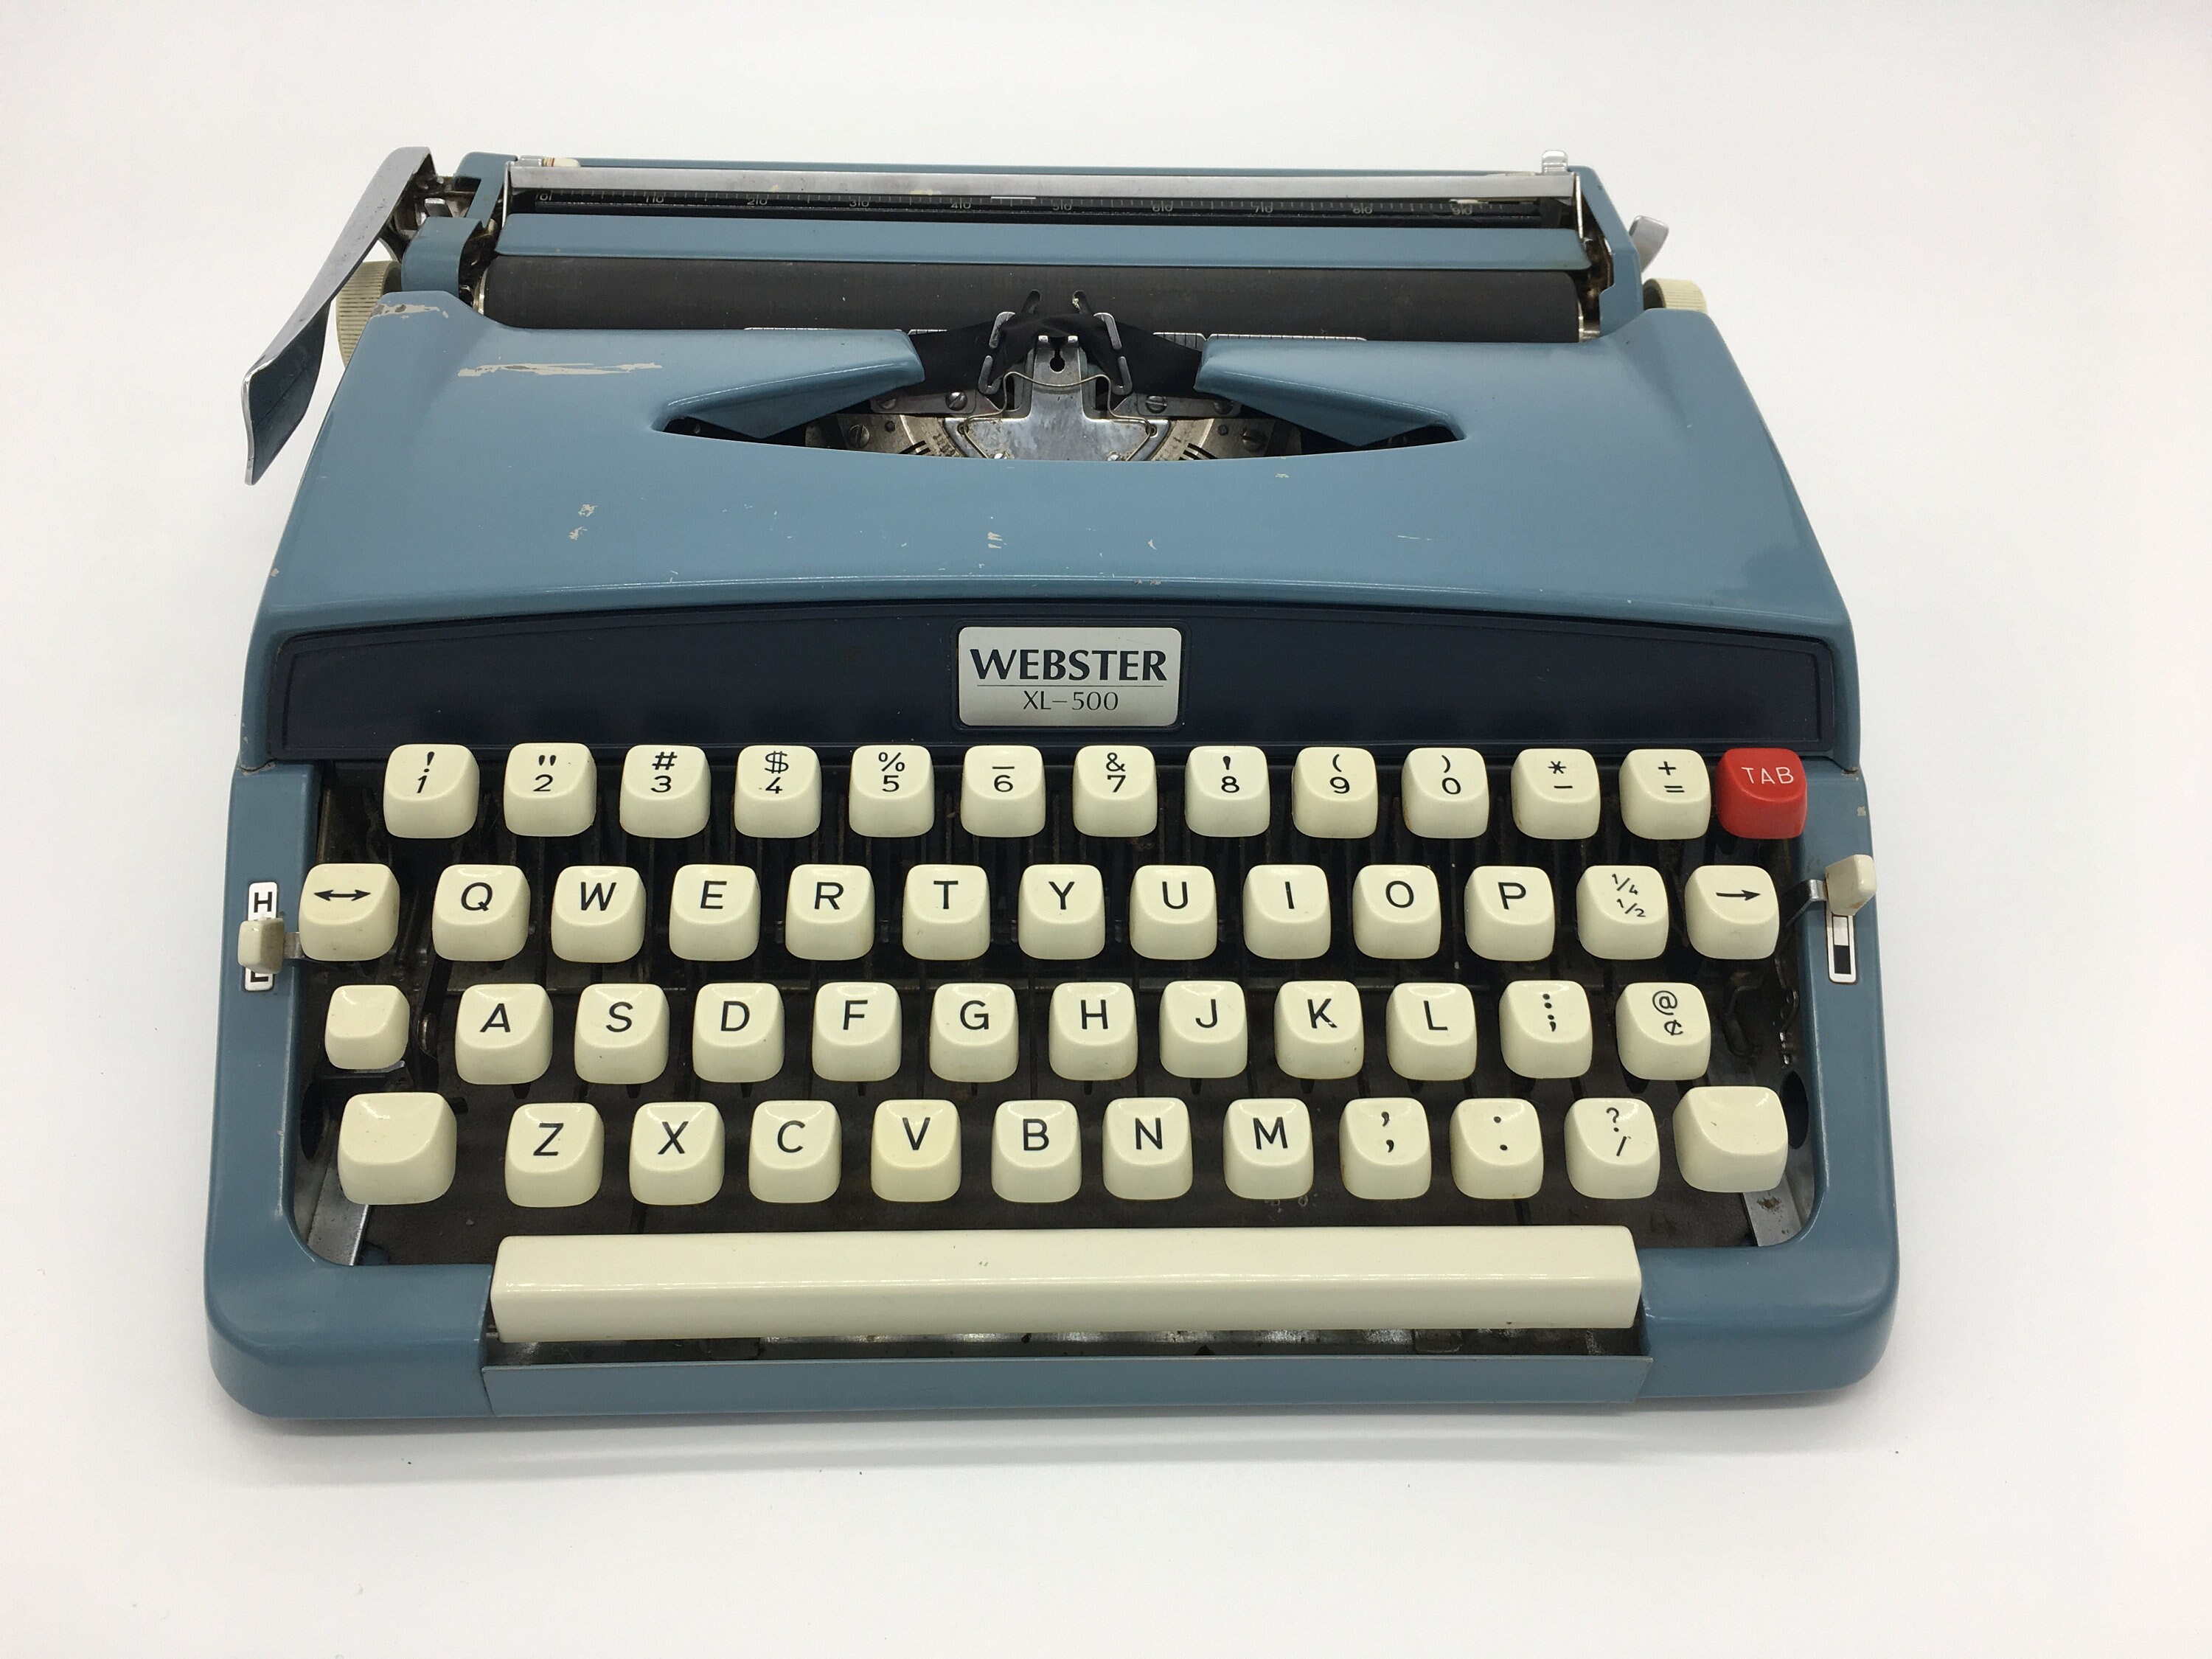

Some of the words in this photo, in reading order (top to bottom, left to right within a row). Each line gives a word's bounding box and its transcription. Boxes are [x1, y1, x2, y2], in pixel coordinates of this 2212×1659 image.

[969, 649, 1168, 681] WEBSTER
[651, 751, 678, 771] #
[764, 751, 790, 774] $
[877, 751, 905, 772] %
[1105, 752, 1126, 772] &
[1332, 754, 1342, 773] (
[1441, 754, 1451, 773] )
[1658, 760, 1677, 776] +
[417, 775, 428, 794] 1
[532, 773, 554, 792] 2
[650, 775, 672, 793] 3
[765, 776, 783, 796] 4
[882, 774, 900, 793] 5
[993, 774, 1014, 793] 6
[1107, 774, 1127, 793] 7
[1220, 775, 1240, 793] 8
[1329, 776, 1350, 794] 9
[1441, 777, 1461, 795] 0
[1741, 767, 1795, 785] TAB
[253, 891, 273, 914] H
[460, 882, 493, 912] Q
[580, 881, 617, 911] W
[700, 880, 728, 910] E
[814, 881, 844, 911] R
[933, 880, 959, 910] T
[1048, 880, 1075, 911] Y
[1161, 880, 1189, 910] U
[1284, 881, 1295, 910] I
[1385, 880, 1414, 908] O
[1498, 881, 1527, 911] P
[605, 1001, 633, 1033] S
[720, 1000, 751, 1032] D
[843, 999, 869, 1031] F
[959, 1000, 990, 1031] G
[1080, 999, 1109, 1030] H
[1195, 998, 1218, 1029] J
[1308, 998, 1337, 1029] K
[1423, 1000, 1449, 1031] L
[1652, 990, 1678, 1016] @
[479, 1003, 511, 1033] A
[1663, 1019, 1684, 1037] ¢
[902, 1116, 931, 1151] V
[1135, 1117, 1163, 1150] N
[1252, 1116, 1288, 1150] M
[1606, 1107, 1620, 1133] ?
[535, 1122, 564, 1157] Z
[657, 1121, 689, 1155] X
[776, 1120, 806, 1154] C
[1022, 1118, 1050, 1152] B
[1616, 1136, 1628, 1157] /
